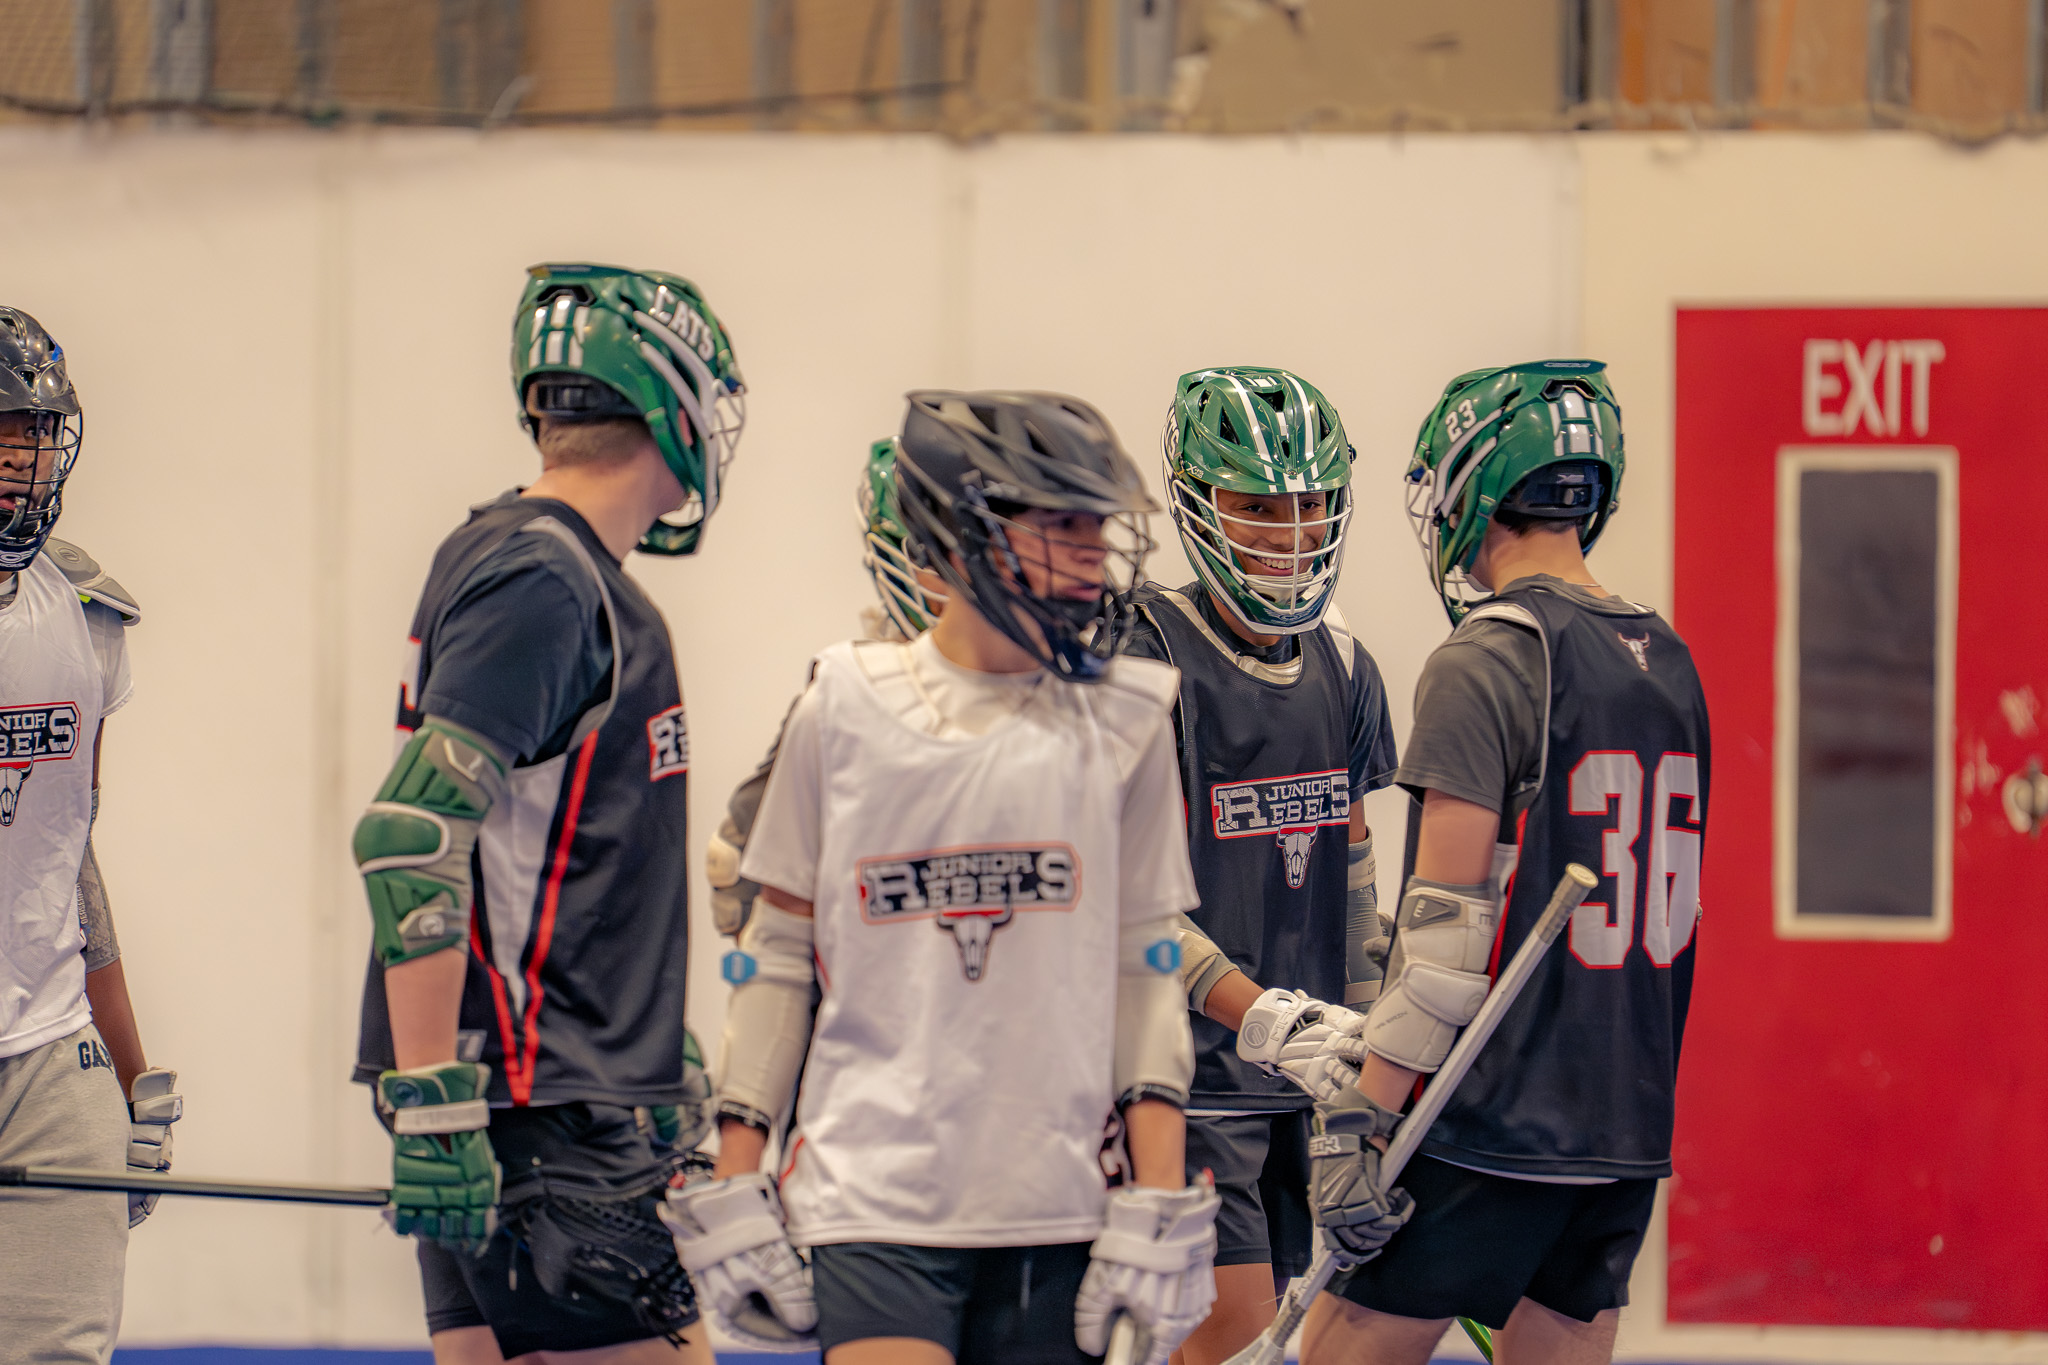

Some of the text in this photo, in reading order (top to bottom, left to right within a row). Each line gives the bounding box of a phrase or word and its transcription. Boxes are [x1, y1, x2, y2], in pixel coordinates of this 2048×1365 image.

[650, 284, 716, 362] CATS
[1803, 338, 1946, 437] EXIT
[1445, 398, 1478, 443] 23
[1217, 775, 1350, 831] REBELS
[1265, 779, 1331, 801] JUNIOR
[866, 850, 1076, 914] REBELS
[920, 853, 1034, 881] JUNIOR
[1568, 750, 1700, 969] 36
